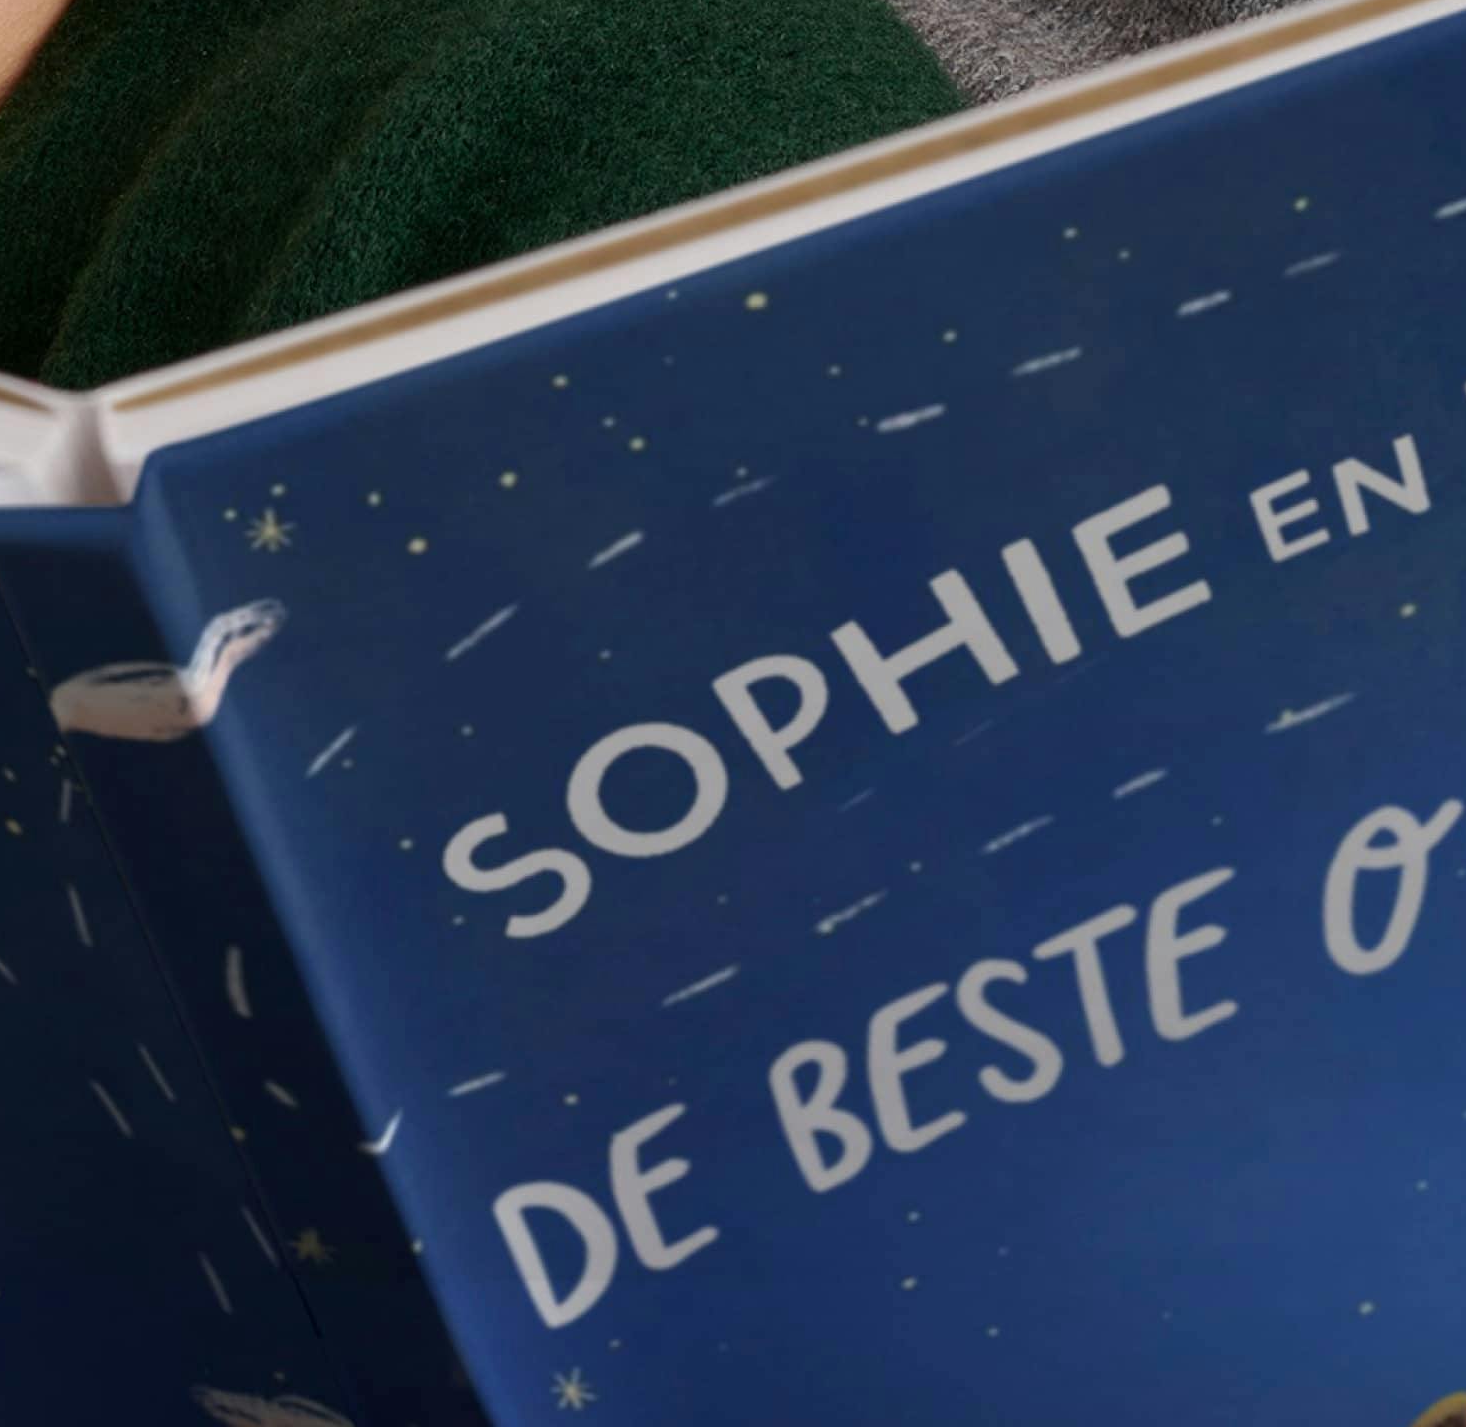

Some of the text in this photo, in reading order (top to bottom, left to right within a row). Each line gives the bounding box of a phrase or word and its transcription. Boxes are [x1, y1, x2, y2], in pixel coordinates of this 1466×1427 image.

[443, 485, 1212, 938] SOPHIE
[1249, 434, 1431, 562] EN
[493, 1104, 717, 1328] DE
[770, 868, 1237, 1192] BESTE
